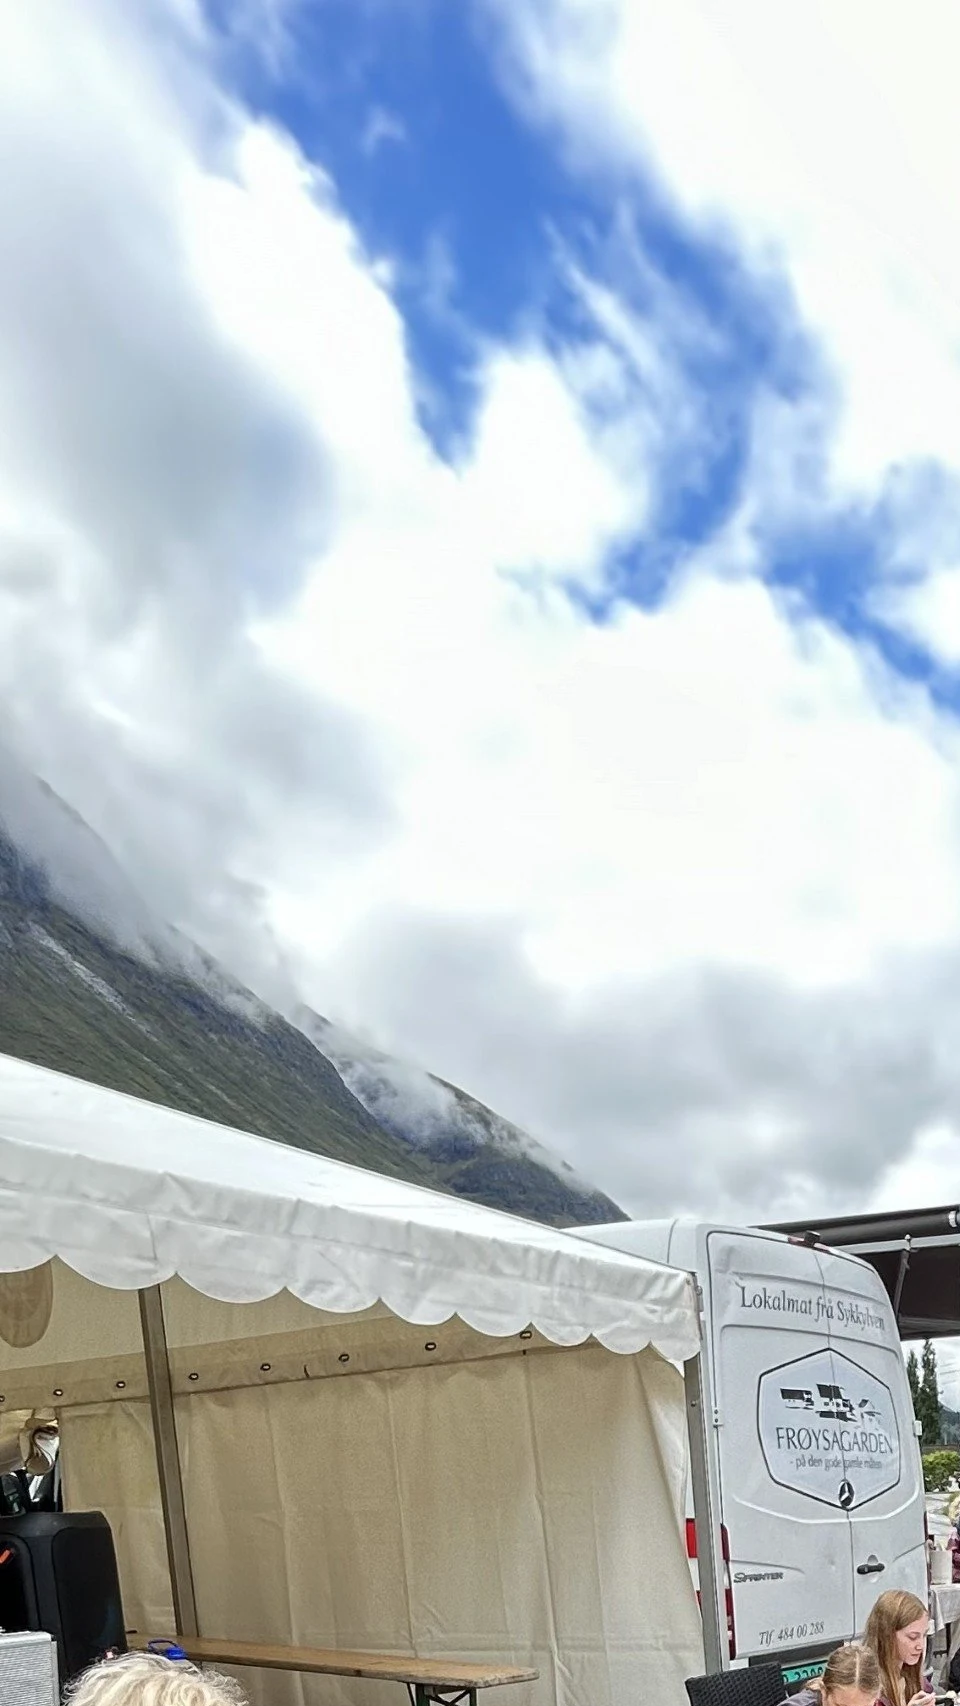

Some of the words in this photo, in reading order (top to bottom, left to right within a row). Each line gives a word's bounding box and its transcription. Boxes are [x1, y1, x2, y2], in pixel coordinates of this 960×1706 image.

[741, 1286, 812, 1315] Lokalmat
[814, 1296, 834, 1322] frå
[837, 1300, 885, 1331] Sykkylven
[776, 1427, 893, 1454] FRØYSAGARDEN
[808, 1455, 822, 1468] den
[778, 1626, 794, 1641] 484
[796, 1624, 807, 1638] 00
[809, 1621, 824, 1636] 288
